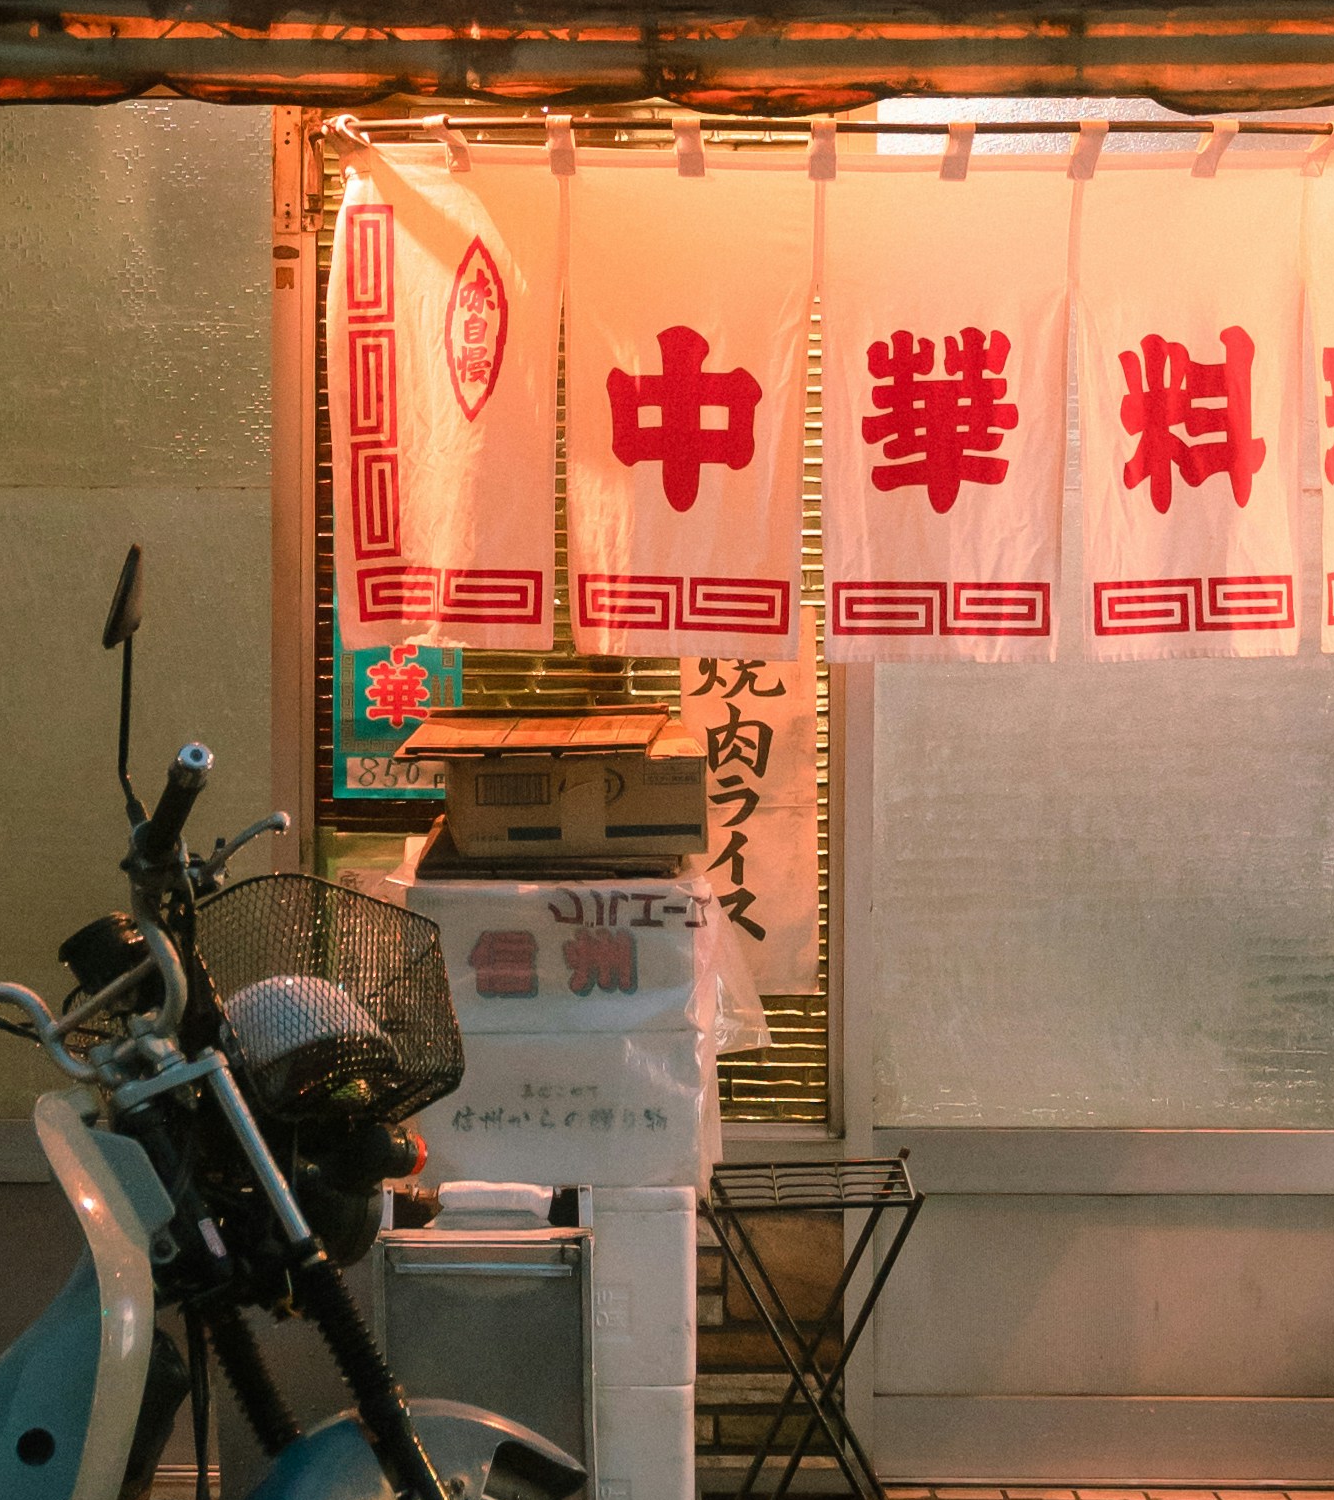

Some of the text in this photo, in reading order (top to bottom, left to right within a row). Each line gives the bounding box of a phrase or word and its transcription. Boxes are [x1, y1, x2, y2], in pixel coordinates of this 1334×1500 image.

[457, 268, 496, 385] 味自慢
[366, 644, 429, 728] 華
[468, 926, 639, 999] 信州
